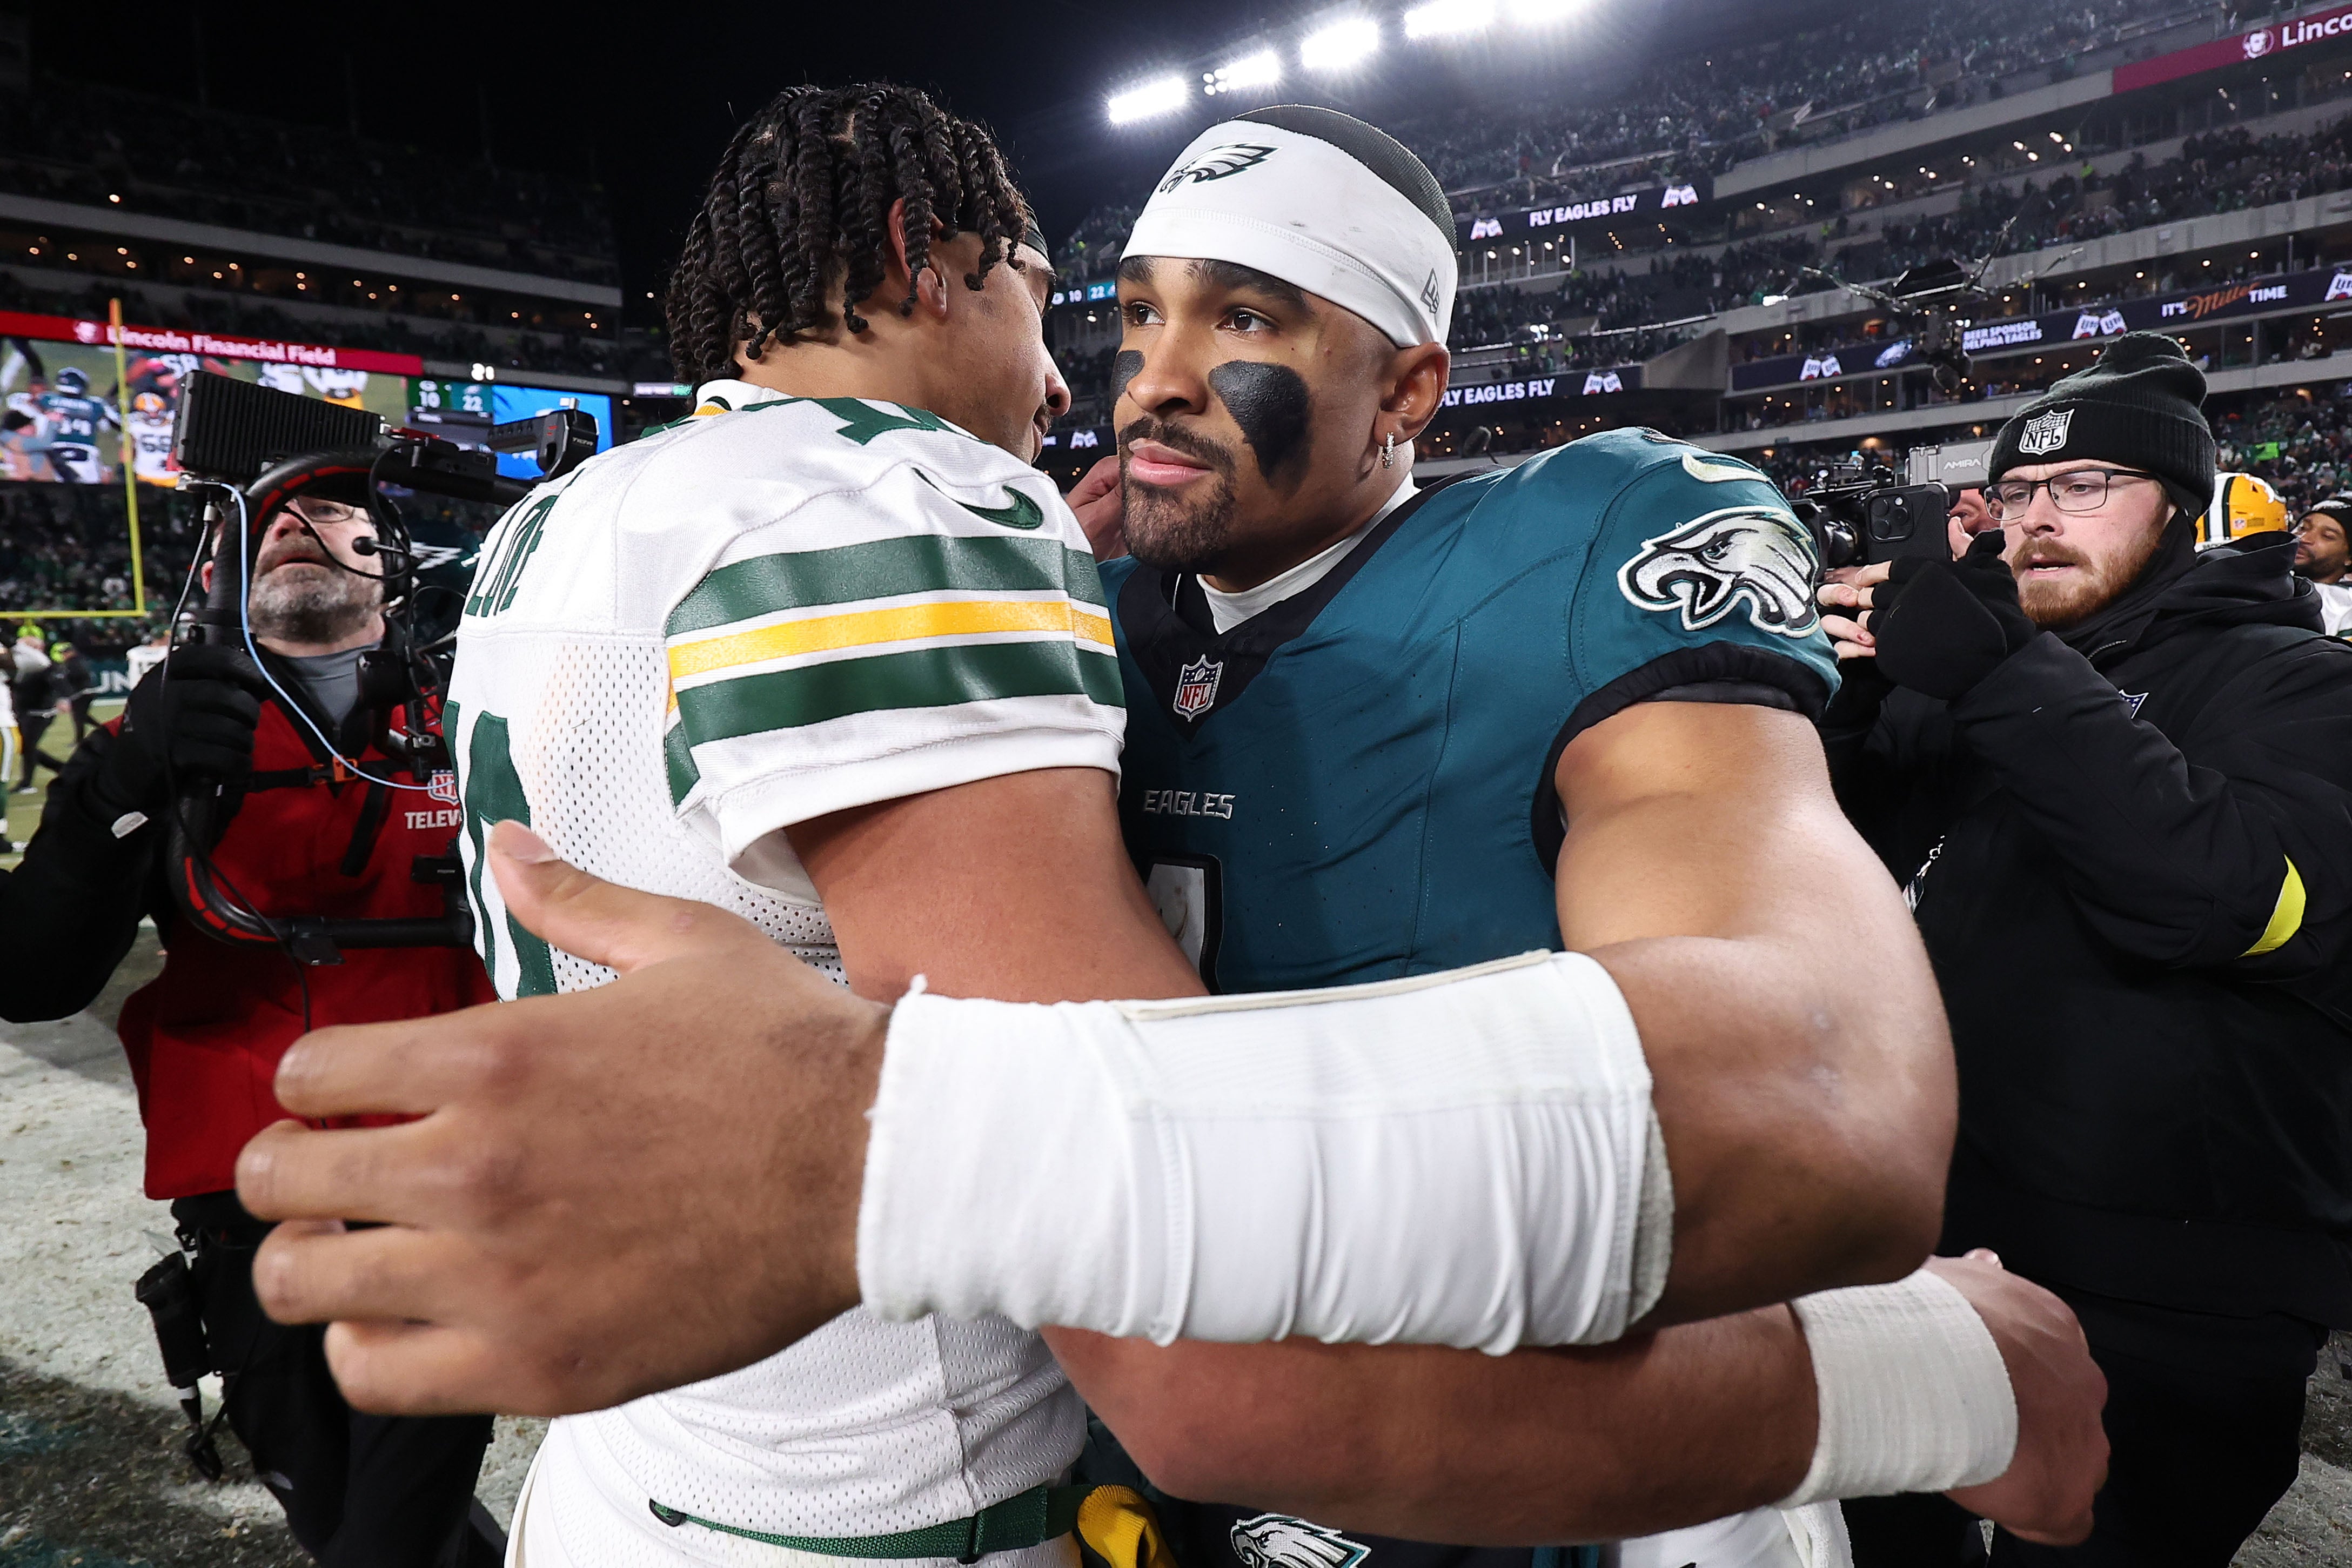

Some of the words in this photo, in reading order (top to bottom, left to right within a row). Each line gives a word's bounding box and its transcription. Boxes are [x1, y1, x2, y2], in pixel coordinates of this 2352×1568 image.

[1530, 209, 1553, 227] FLY
[1554, 199, 1610, 223] EAGLES
[1613, 194, 1637, 213] FLY
[1068, 289, 1082, 302] 10
[1090, 285, 1105, 299] 22
[2249, 285, 2288, 304] TIME
[106, 325, 190, 351] Lincoln
[191, 334, 286, 361] Financial
[287, 344, 337, 366] Field
[419, 390, 440, 408] 10
[462, 394, 483, 412] 22
[1464, 382, 1525, 405] EAGLES
[1528, 378, 1556, 398] FLY
[2025, 426, 2061, 450] NFL
[1944, 458, 1981, 470] AMIRA
[1178, 684, 1208, 709] NFL
[1143, 789, 1236, 820] EAGLES
